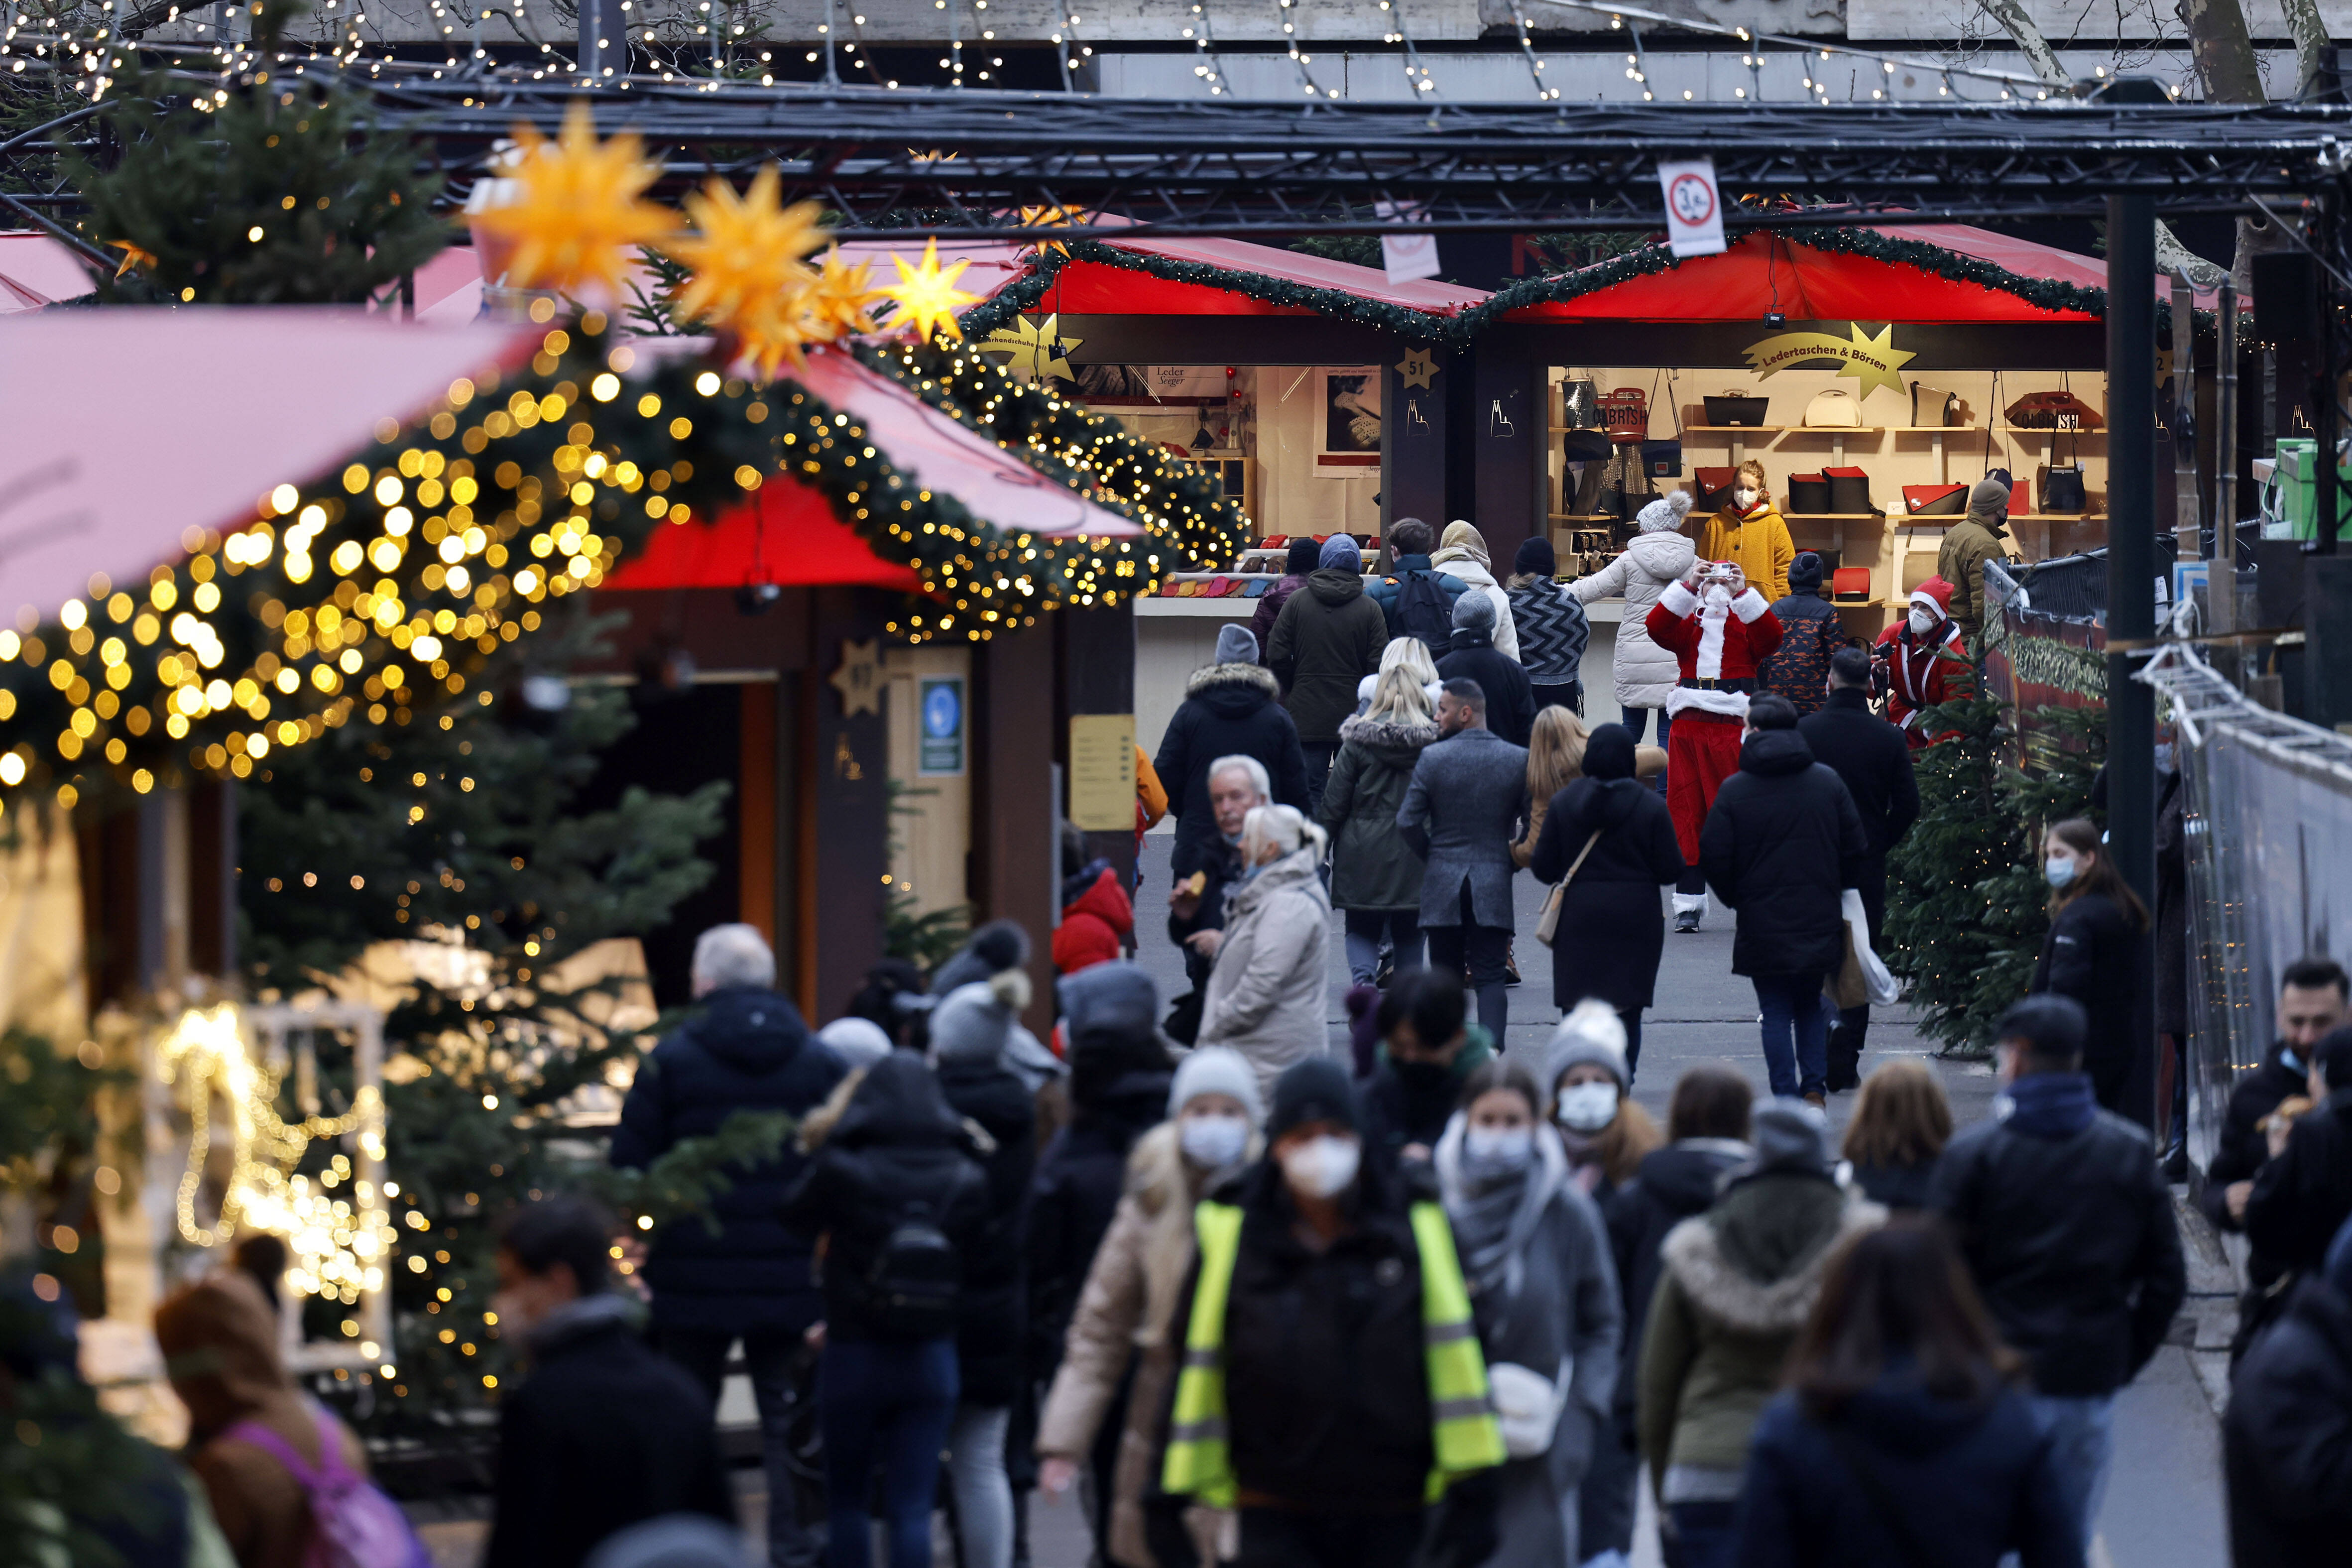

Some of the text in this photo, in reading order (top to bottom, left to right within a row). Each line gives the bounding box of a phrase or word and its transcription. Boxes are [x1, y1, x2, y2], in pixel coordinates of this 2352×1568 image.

[1763, 345, 1887, 372] Ledertaschen & Börsen
[1157, 367, 1184, 376] Leder
[1409, 361, 1423, 375] 51
[1159, 376, 1185, 387] Seeger
